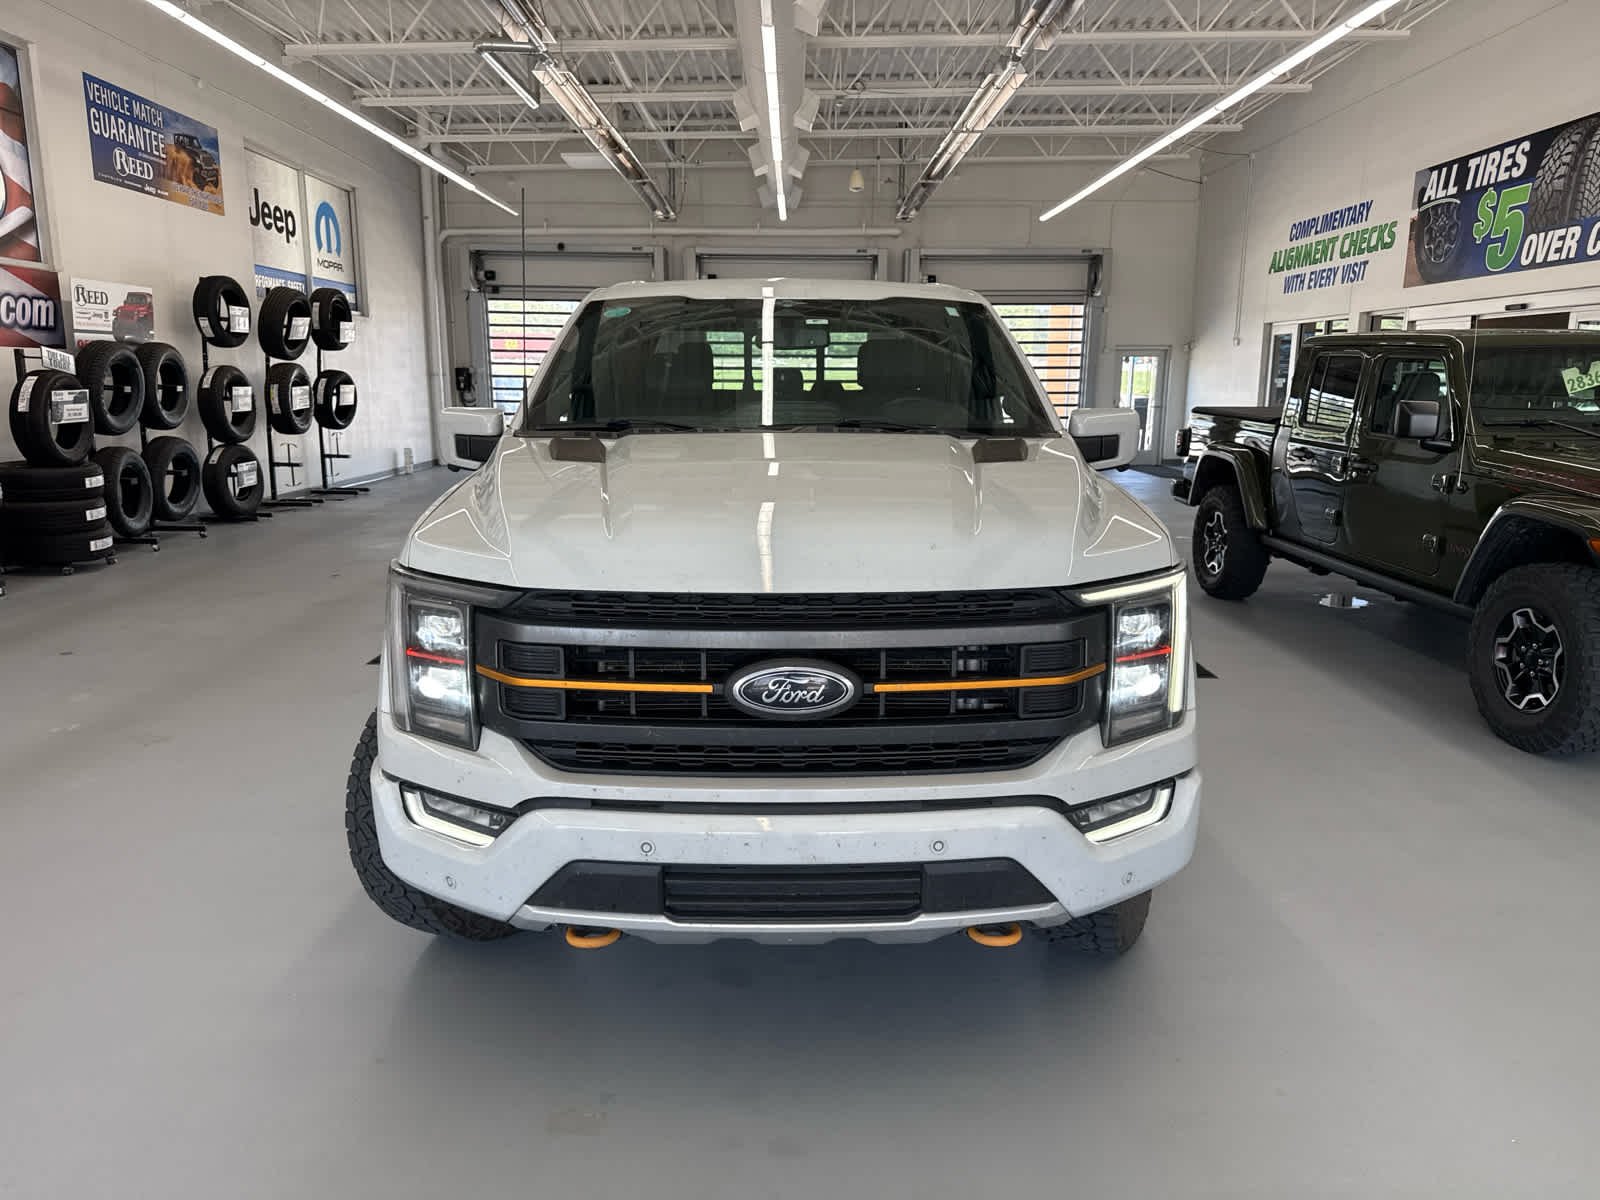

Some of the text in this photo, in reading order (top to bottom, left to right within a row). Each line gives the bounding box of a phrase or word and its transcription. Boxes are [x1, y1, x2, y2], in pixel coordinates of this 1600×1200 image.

[86, 80, 164, 129] VEHICLE MATCH
[90, 108, 167, 159] GUARANTEE
[113, 147, 154, 180] REED
[1423, 140, 1531, 203] ALL TIRES
[249, 187, 296, 244] Jeep
[1289, 200, 1374, 242] COMPLIMENTARY
[1473, 183, 1533, 272] $5
[1268, 221, 1398, 274] ALIGNMENT CHECKS
[1520, 226, 1581, 266] OVER
[74, 284, 109, 306] REED
[1283, 260, 1369, 294] WITH EVERY VISIT
[762, 677, 825, 704] Ford
